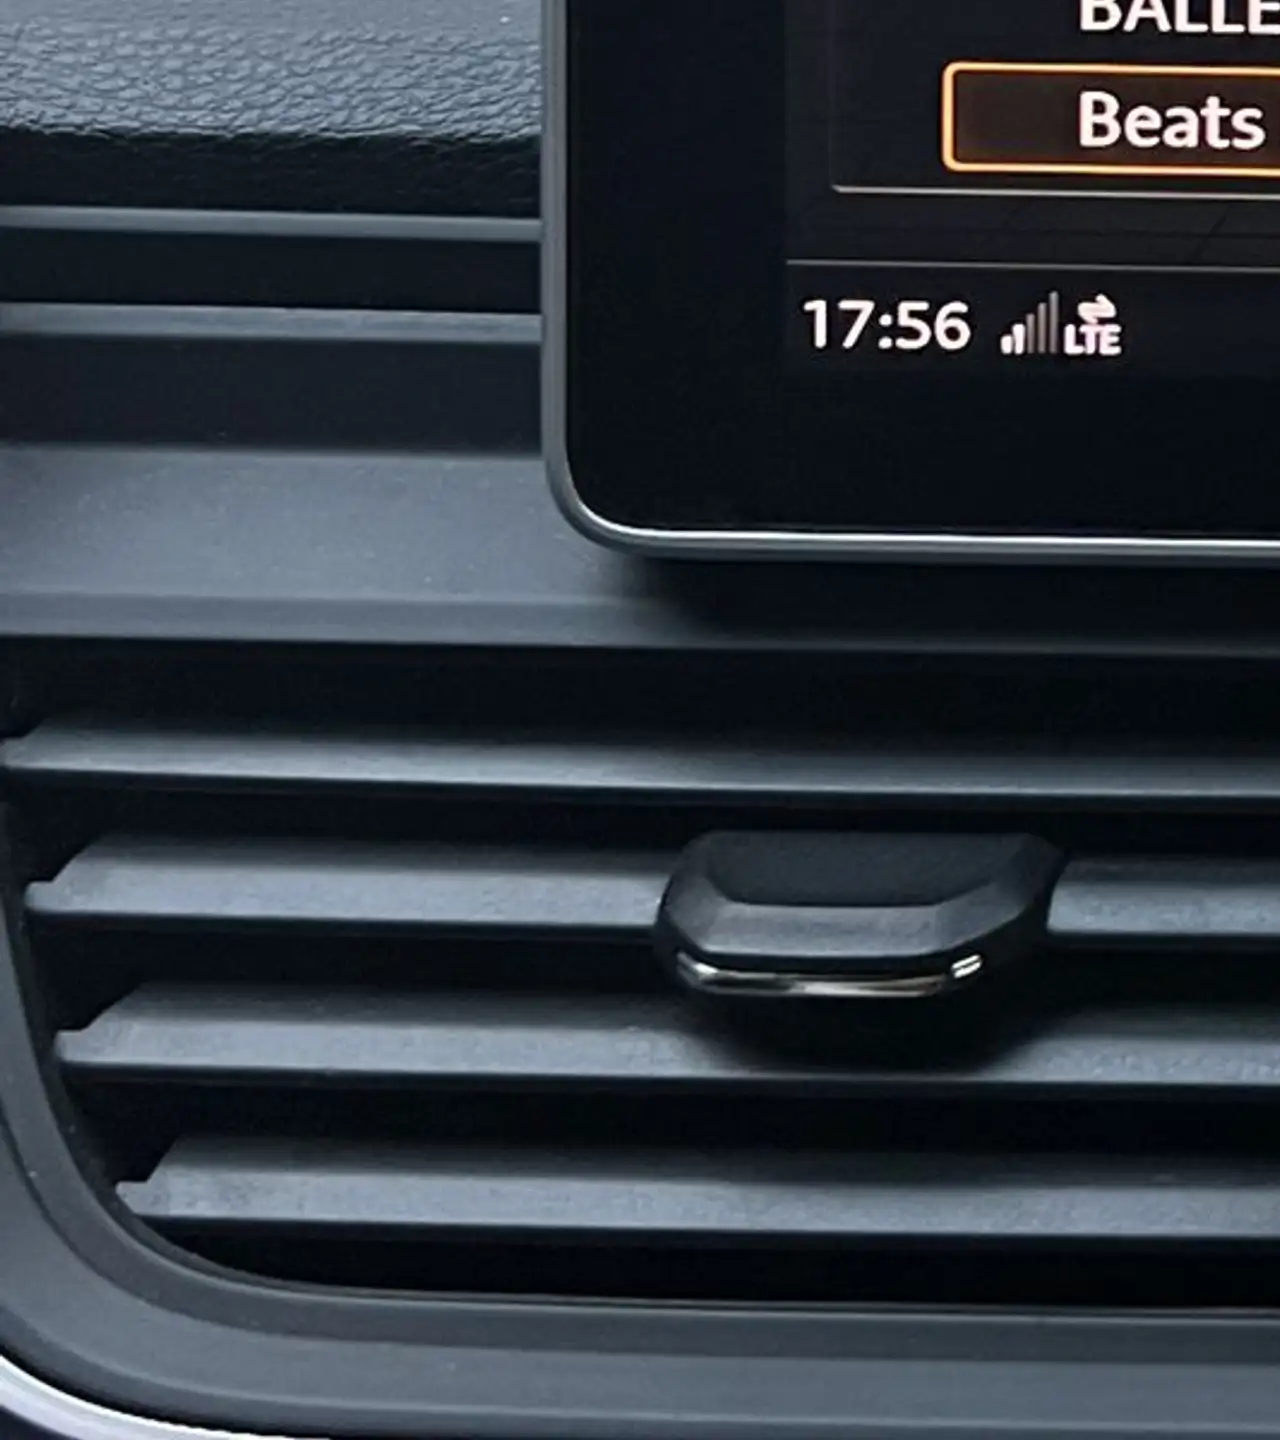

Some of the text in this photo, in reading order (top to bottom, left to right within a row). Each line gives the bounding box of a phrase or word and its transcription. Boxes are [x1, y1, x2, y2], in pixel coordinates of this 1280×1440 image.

[1079, 90, 1266, 150] Beats
[803, 299, 971, 350] 17:56
[1063, 322, 1122, 356] LTE
